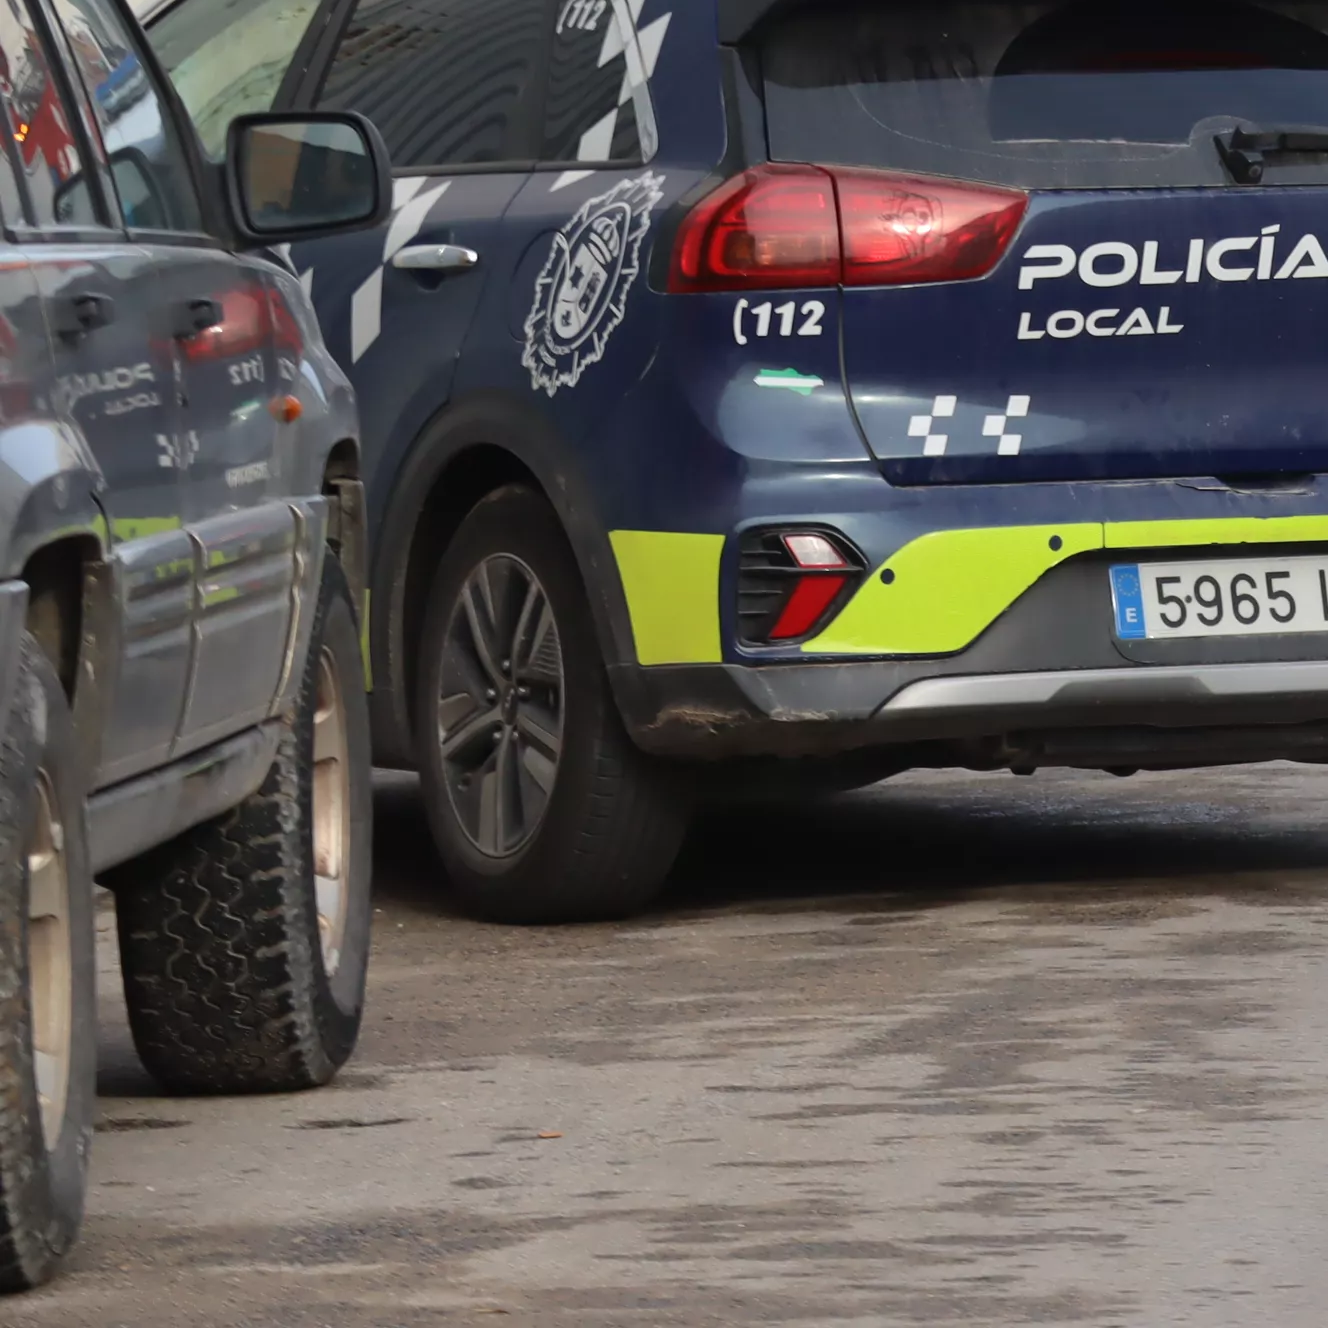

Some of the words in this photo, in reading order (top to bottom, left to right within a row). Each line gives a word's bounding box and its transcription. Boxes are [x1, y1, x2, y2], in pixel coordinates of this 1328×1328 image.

[1017, 306, 1184, 340] LOCAL
[1125, 608, 1137, 623] E
[1155, 571, 1296, 629] 5965
